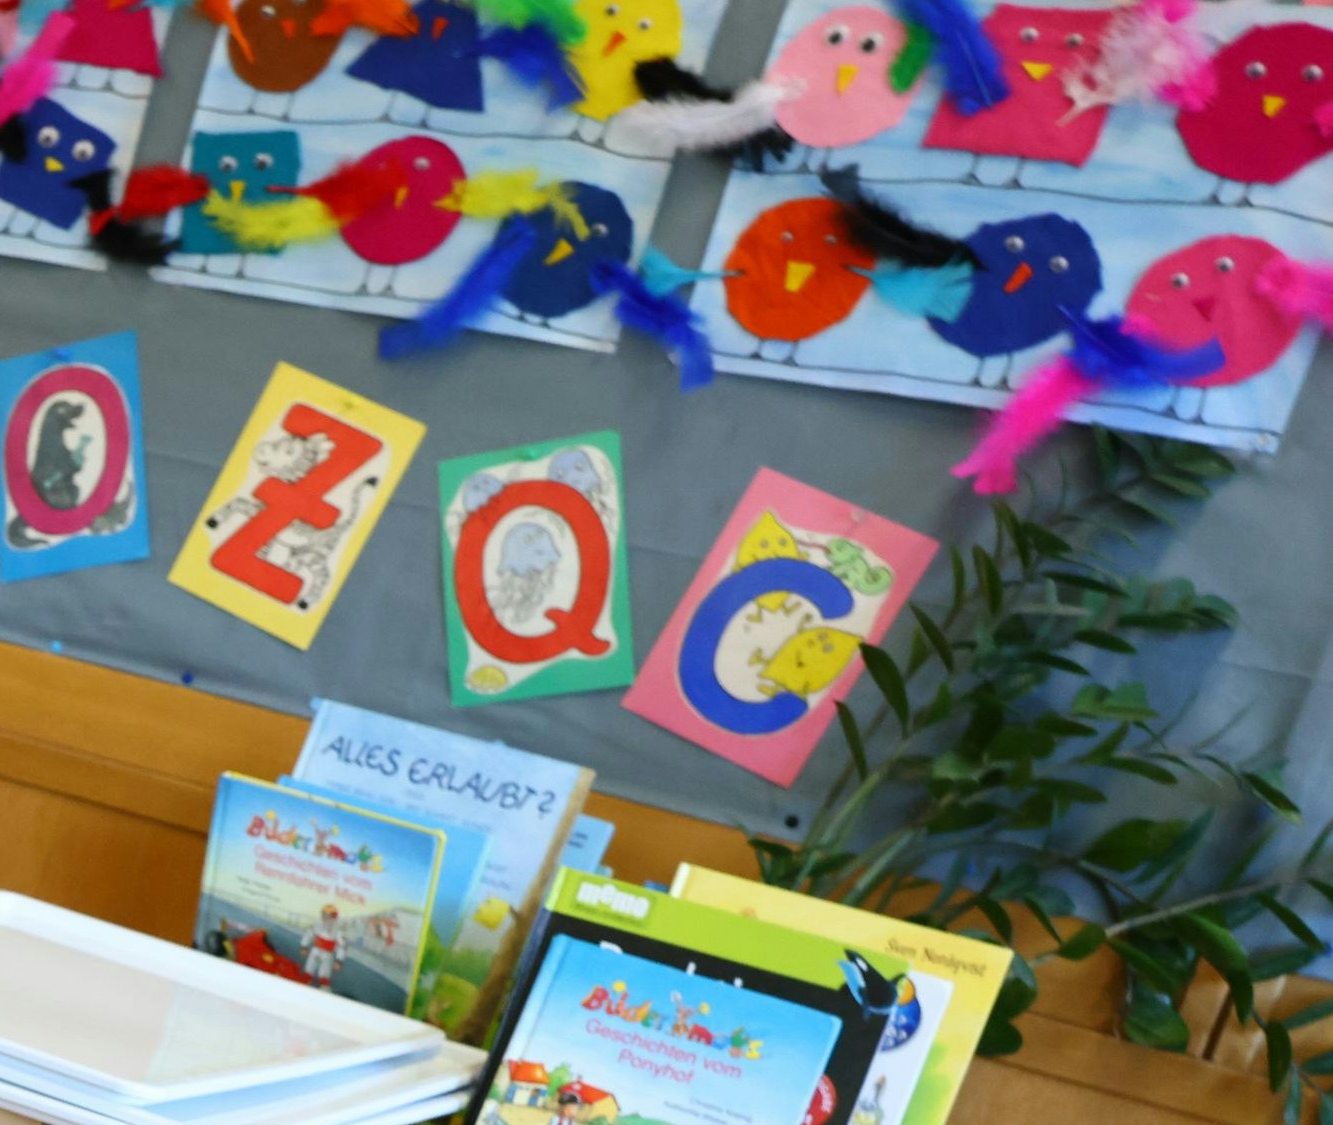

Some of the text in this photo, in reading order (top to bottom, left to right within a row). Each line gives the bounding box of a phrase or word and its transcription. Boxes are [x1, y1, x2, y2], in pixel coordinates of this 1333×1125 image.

[3, 363, 131, 537] O
[209, 401, 384, 608] Z
[453, 478, 613, 664] Q
[677, 556, 855, 736] C
[323, 735, 402, 777] ALLES
[585, 1017, 742, 1079] Geschichten vom
[617, 1047, 694, 1084] Ponyhof
